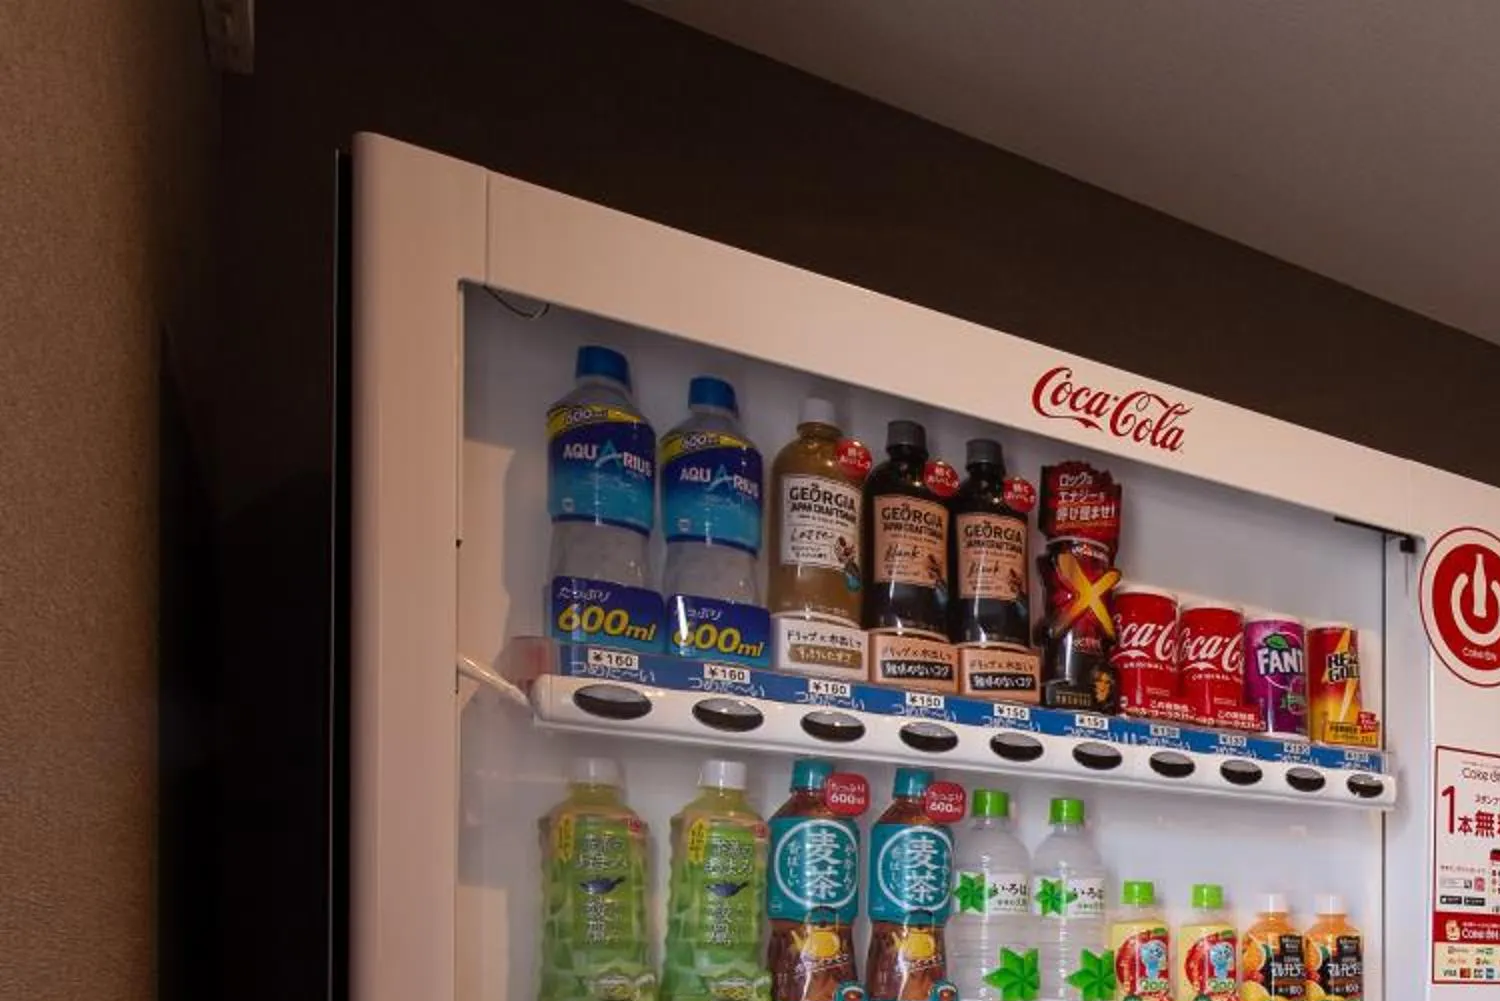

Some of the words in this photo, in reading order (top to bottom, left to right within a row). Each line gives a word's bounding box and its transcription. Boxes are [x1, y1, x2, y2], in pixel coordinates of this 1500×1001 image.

[1032, 367, 1193, 451] Coca-Cola
[563, 440, 653, 478] AQUARIUS
[680, 464, 759, 498] AQUARIUS
[557, 604, 657, 641] 600ml
[673, 607, 723, 621] っぷり
[672, 622, 764, 657] 600ml
[592, 652, 633, 667] ¥160
[709, 667, 745, 681] ¥160
[1257, 645, 1304, 676] FANT
[807, 828, 843, 899] 麦茶
[907, 836, 939, 902] 麦茶
